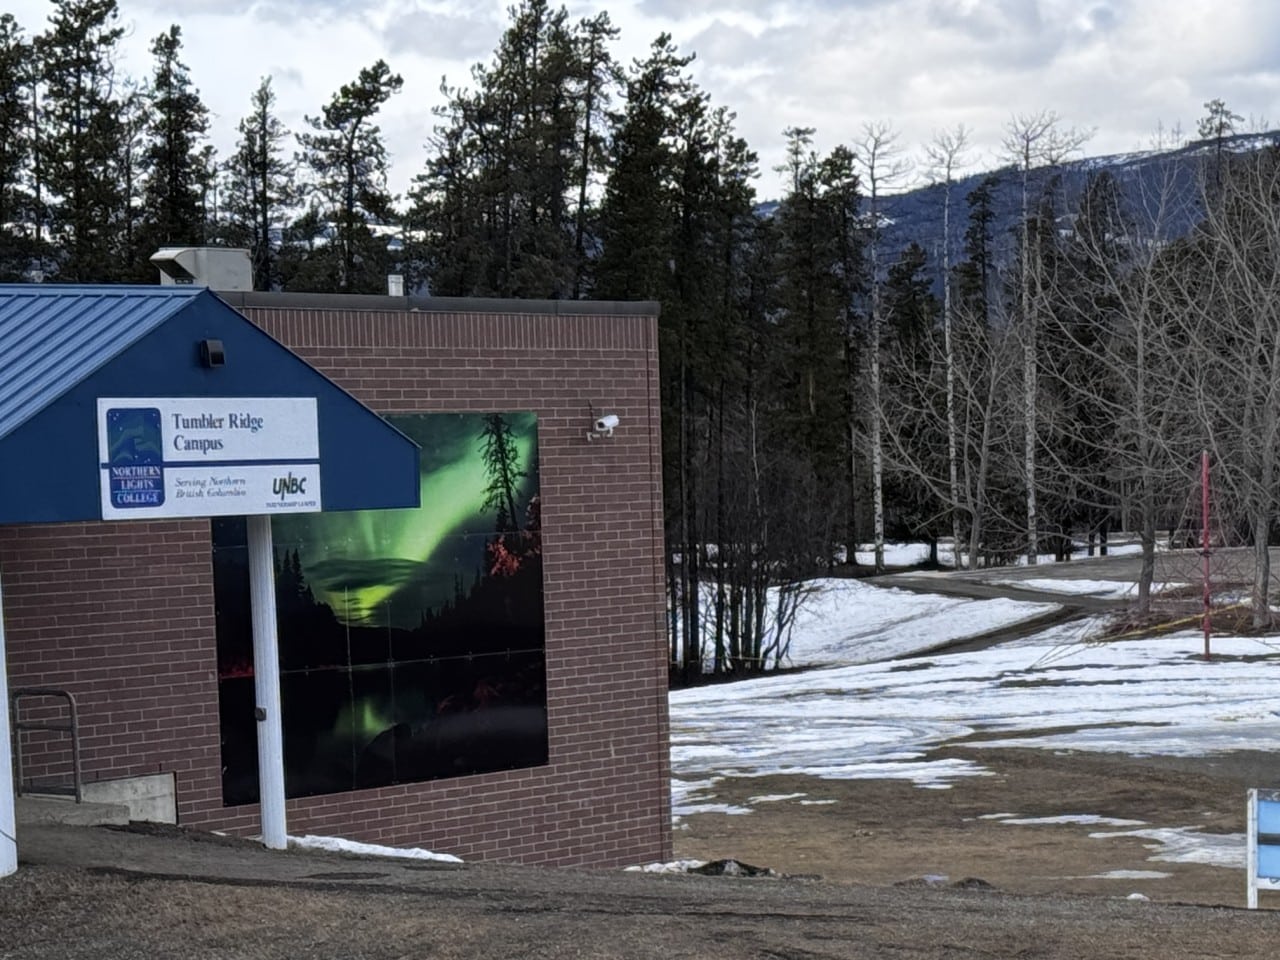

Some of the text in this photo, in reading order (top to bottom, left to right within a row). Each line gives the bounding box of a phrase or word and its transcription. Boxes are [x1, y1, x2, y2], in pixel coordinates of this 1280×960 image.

[172, 412, 263, 432] Tumbler Ridge
[173, 435, 223, 454] Campus
[112, 466, 161, 477] NORTHERN
[121, 479, 155, 490] LIGHTS
[175, 477, 246, 489] Serving Northern
[273, 471, 307, 502] UNBC
[116, 493, 159, 504] COLLEGE
[176, 488, 246, 499] British Columbia
